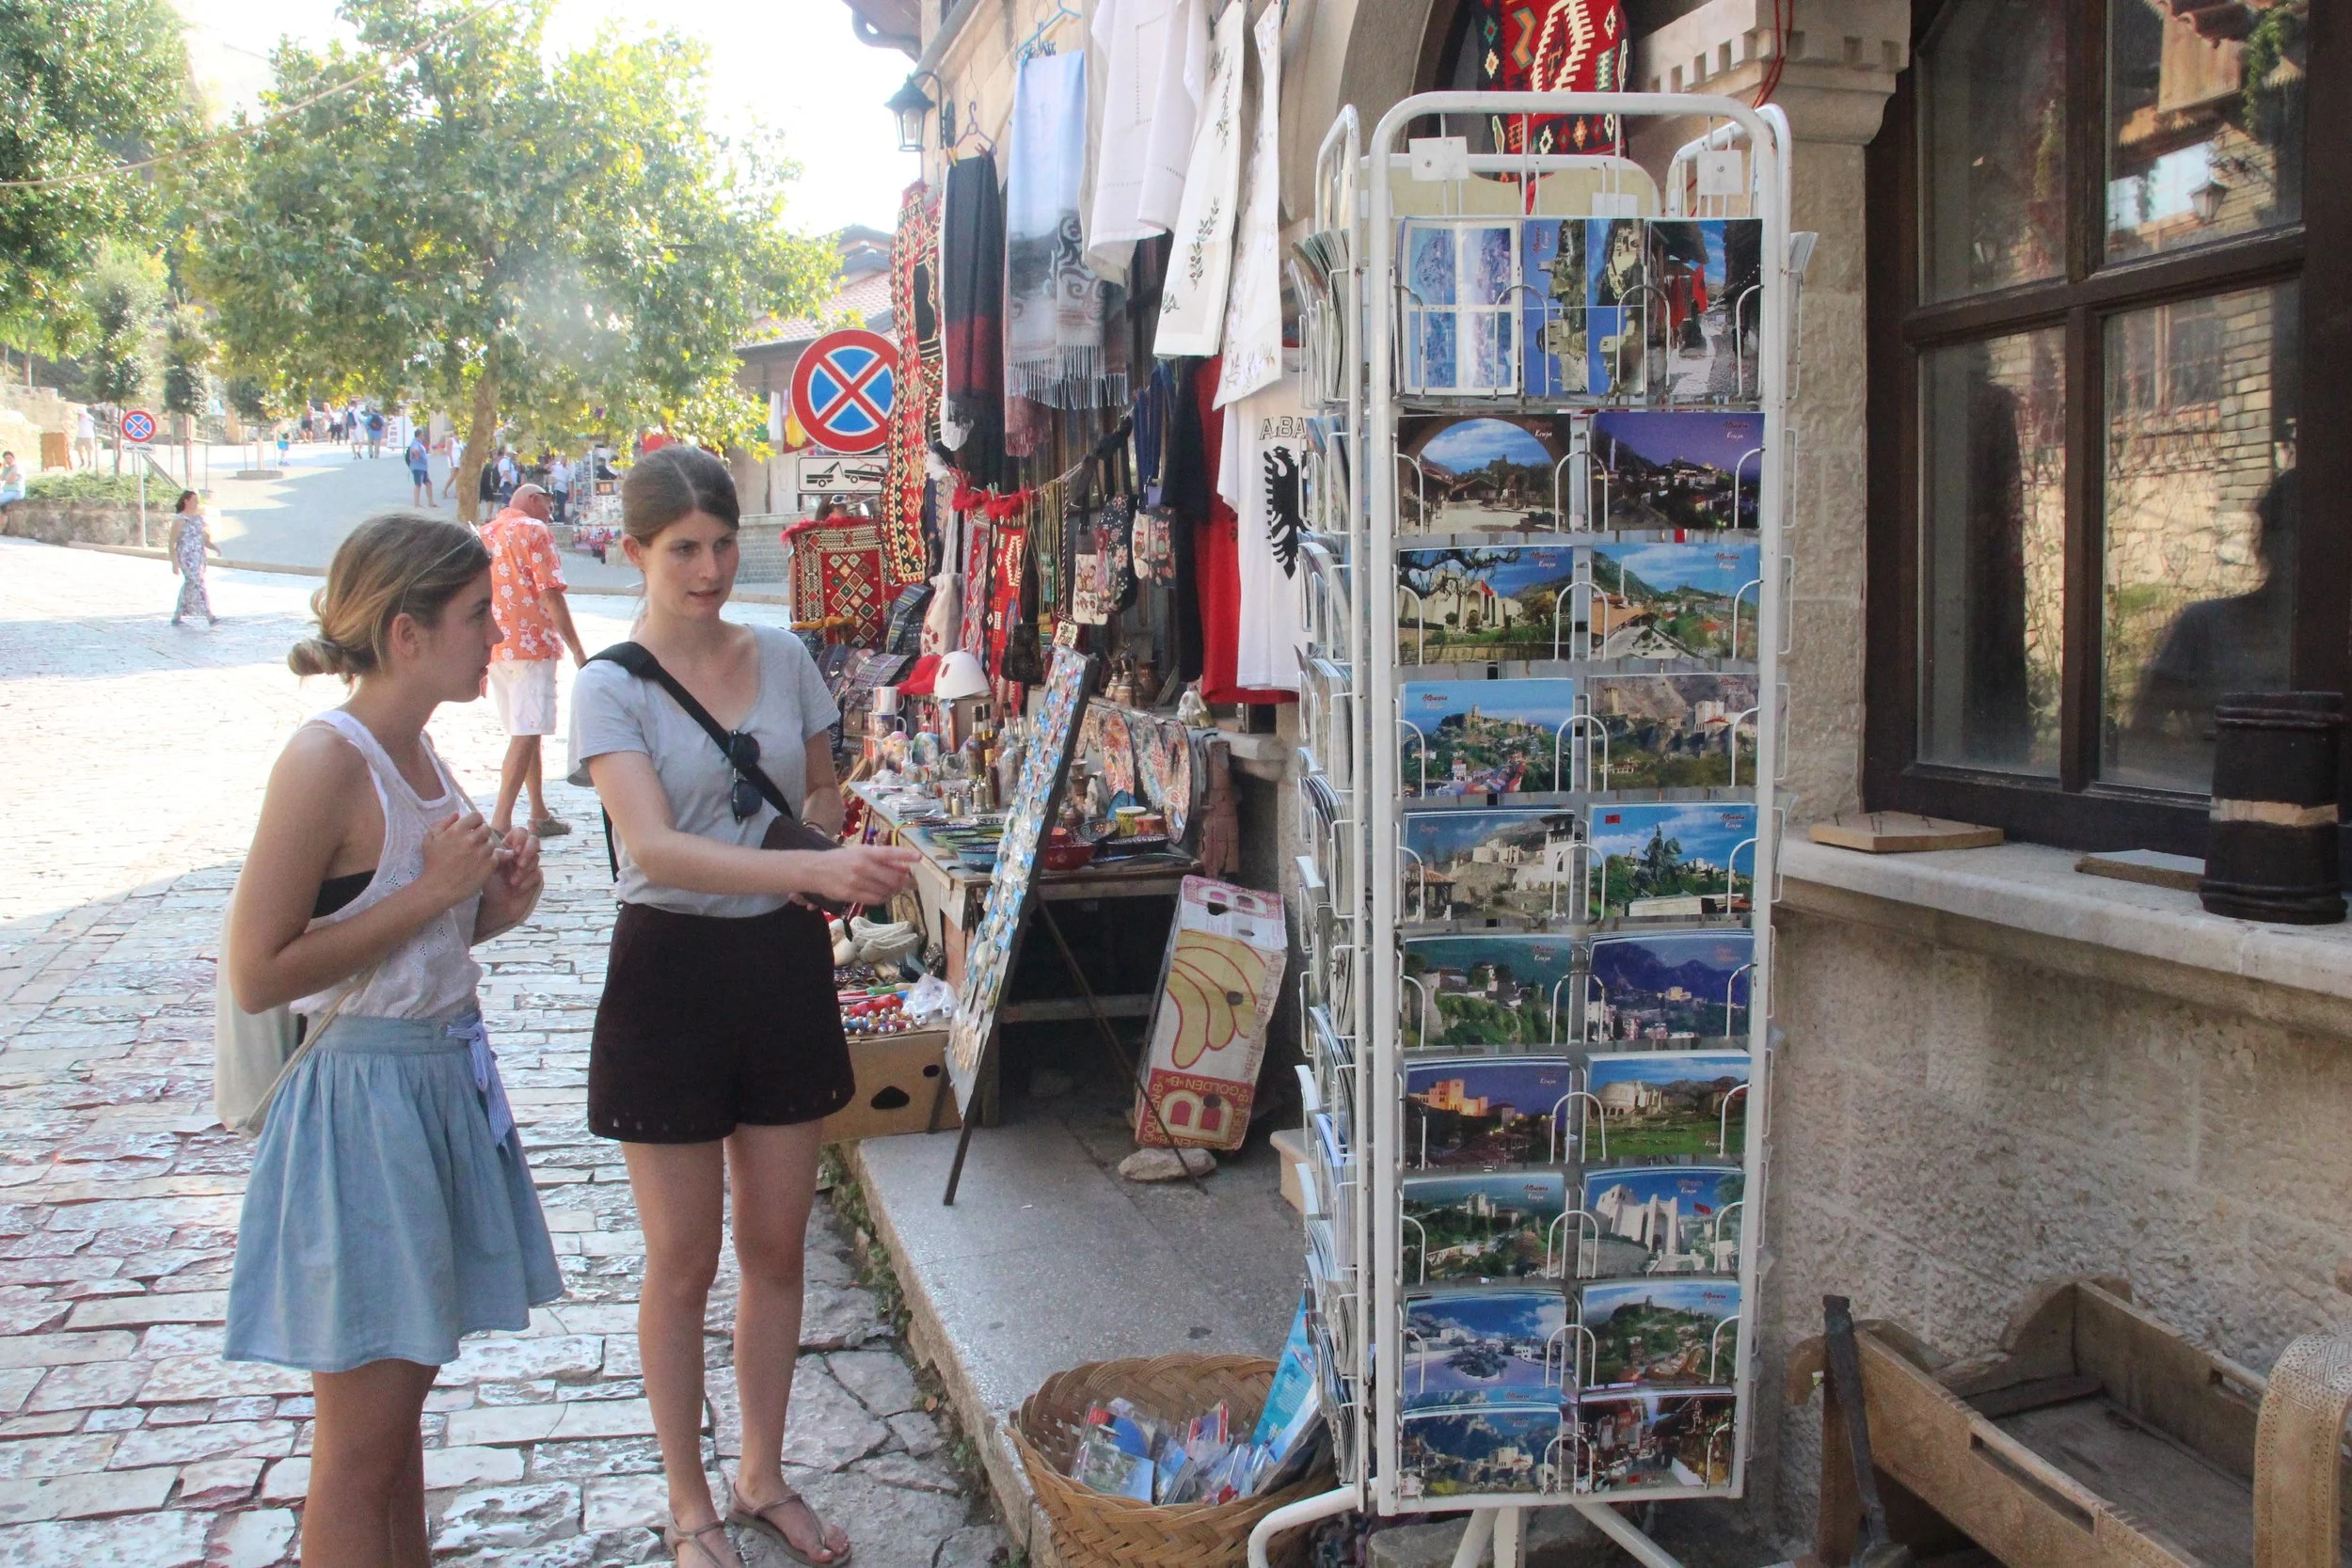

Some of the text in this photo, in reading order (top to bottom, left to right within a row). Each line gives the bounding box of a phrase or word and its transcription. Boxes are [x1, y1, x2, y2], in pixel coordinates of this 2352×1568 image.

[1534, 429, 1553, 440] Kruja
[1726, 432, 1744, 440] Kruja
[1538, 561, 1557, 569] Kruja
[1534, 954, 1551, 964] Kruja
[1185, 1078, 1239, 1096] GOLDEN
[1539, 1078, 1557, 1087] Kruja
